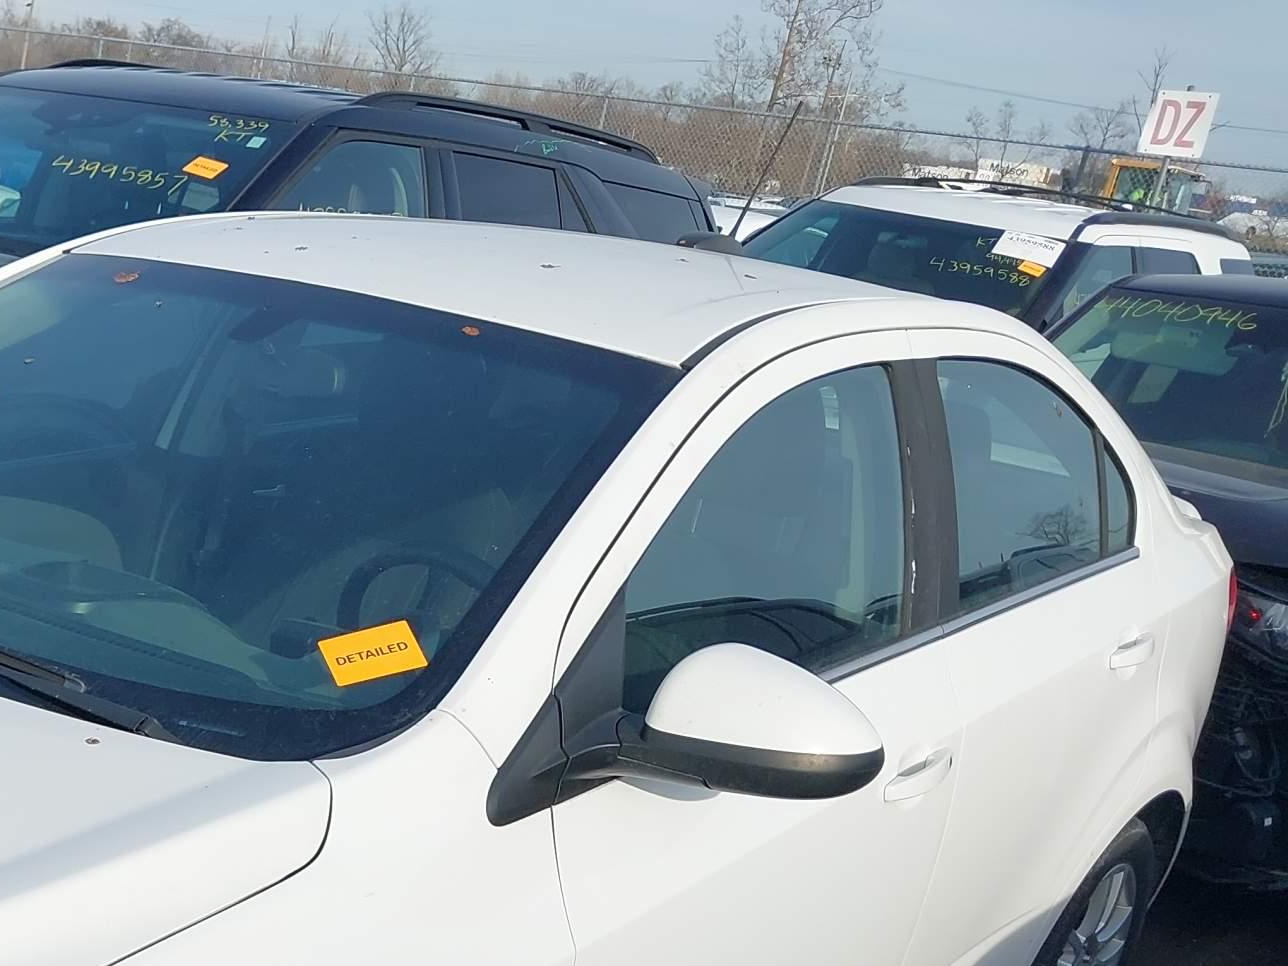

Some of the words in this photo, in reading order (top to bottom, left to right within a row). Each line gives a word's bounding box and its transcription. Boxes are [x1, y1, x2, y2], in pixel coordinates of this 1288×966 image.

[1150, 99, 1207, 148] DZ
[51, 155, 188, 196] 43995857
[929, 256, 1031, 288] 43959588
[335, 641, 409, 666] DETAILED
